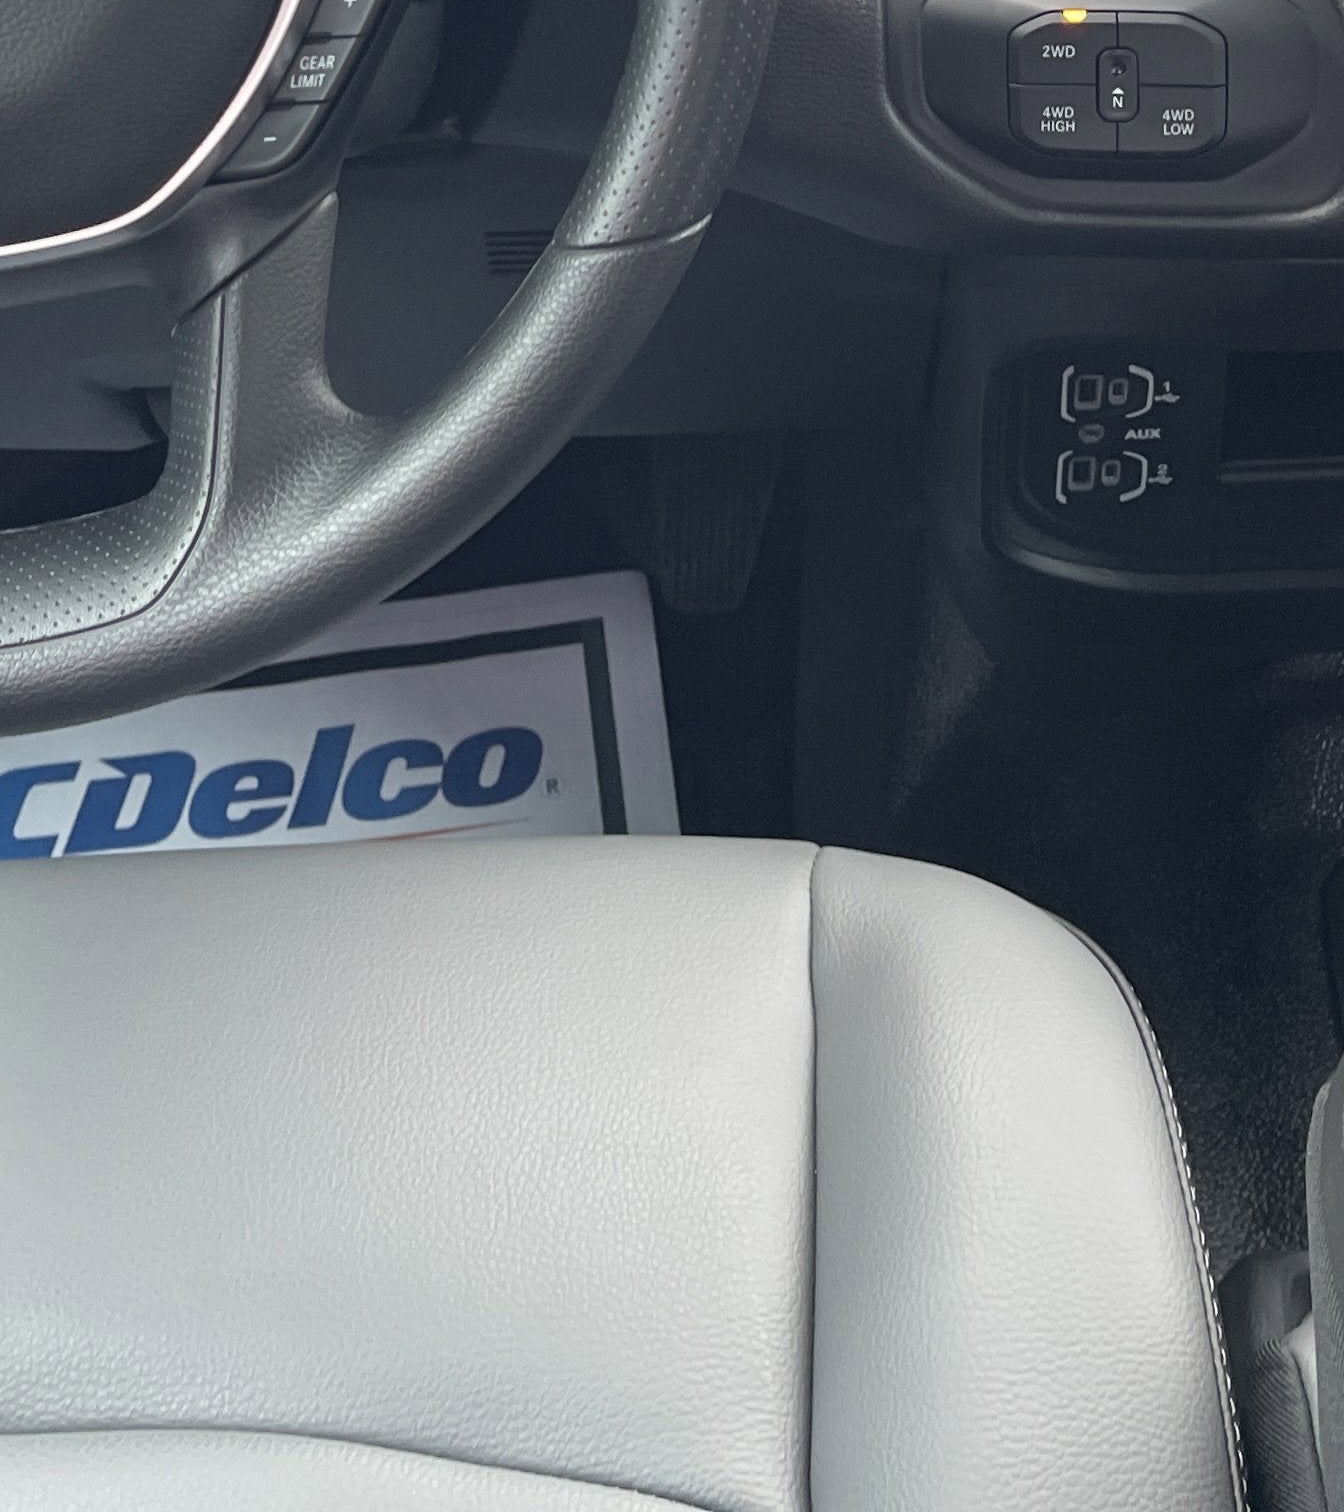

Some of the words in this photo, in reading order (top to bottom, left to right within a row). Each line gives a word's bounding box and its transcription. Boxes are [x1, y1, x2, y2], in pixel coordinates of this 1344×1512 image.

[1041, 45, 1076, 59] 2WD
[299, 54, 336, 71] GEAR
[290, 73, 326, 88] LIMIT
[1112, 95, 1123, 109] N
[1042, 106, 1075, 119] 4WD
[1161, 109, 1195, 122] 4WD
[1040, 119, 1076, 134] HIGH
[1162, 122, 1195, 136] LOW
[1124, 427, 1162, 440] AUX
